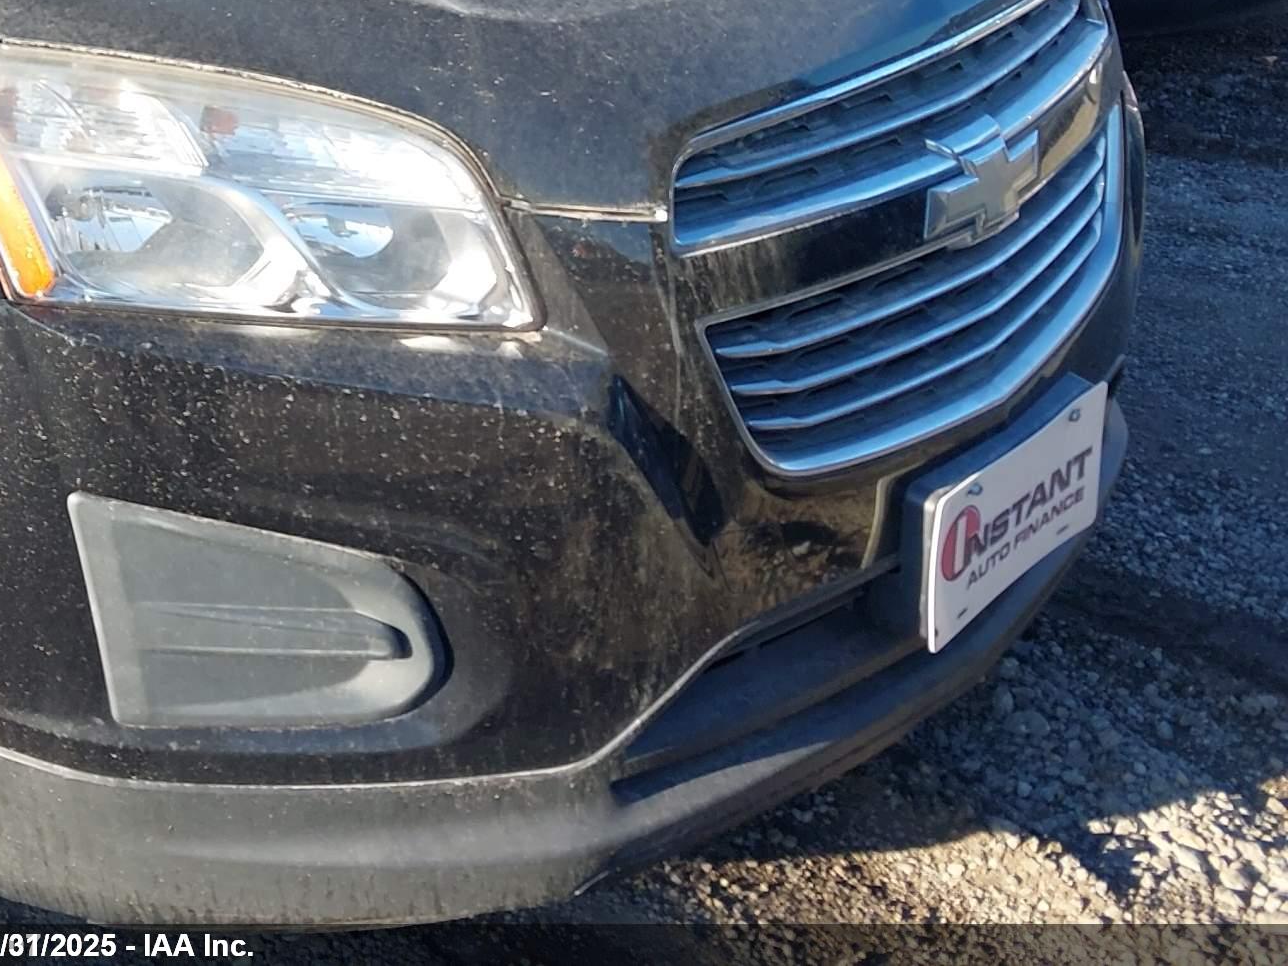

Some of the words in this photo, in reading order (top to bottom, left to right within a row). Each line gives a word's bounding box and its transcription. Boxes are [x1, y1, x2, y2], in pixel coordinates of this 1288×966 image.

[941, 446, 1093, 582] INSTANT
[966, 543, 1011, 590] AUTO
[1014, 486, 1085, 552] FINANCE
